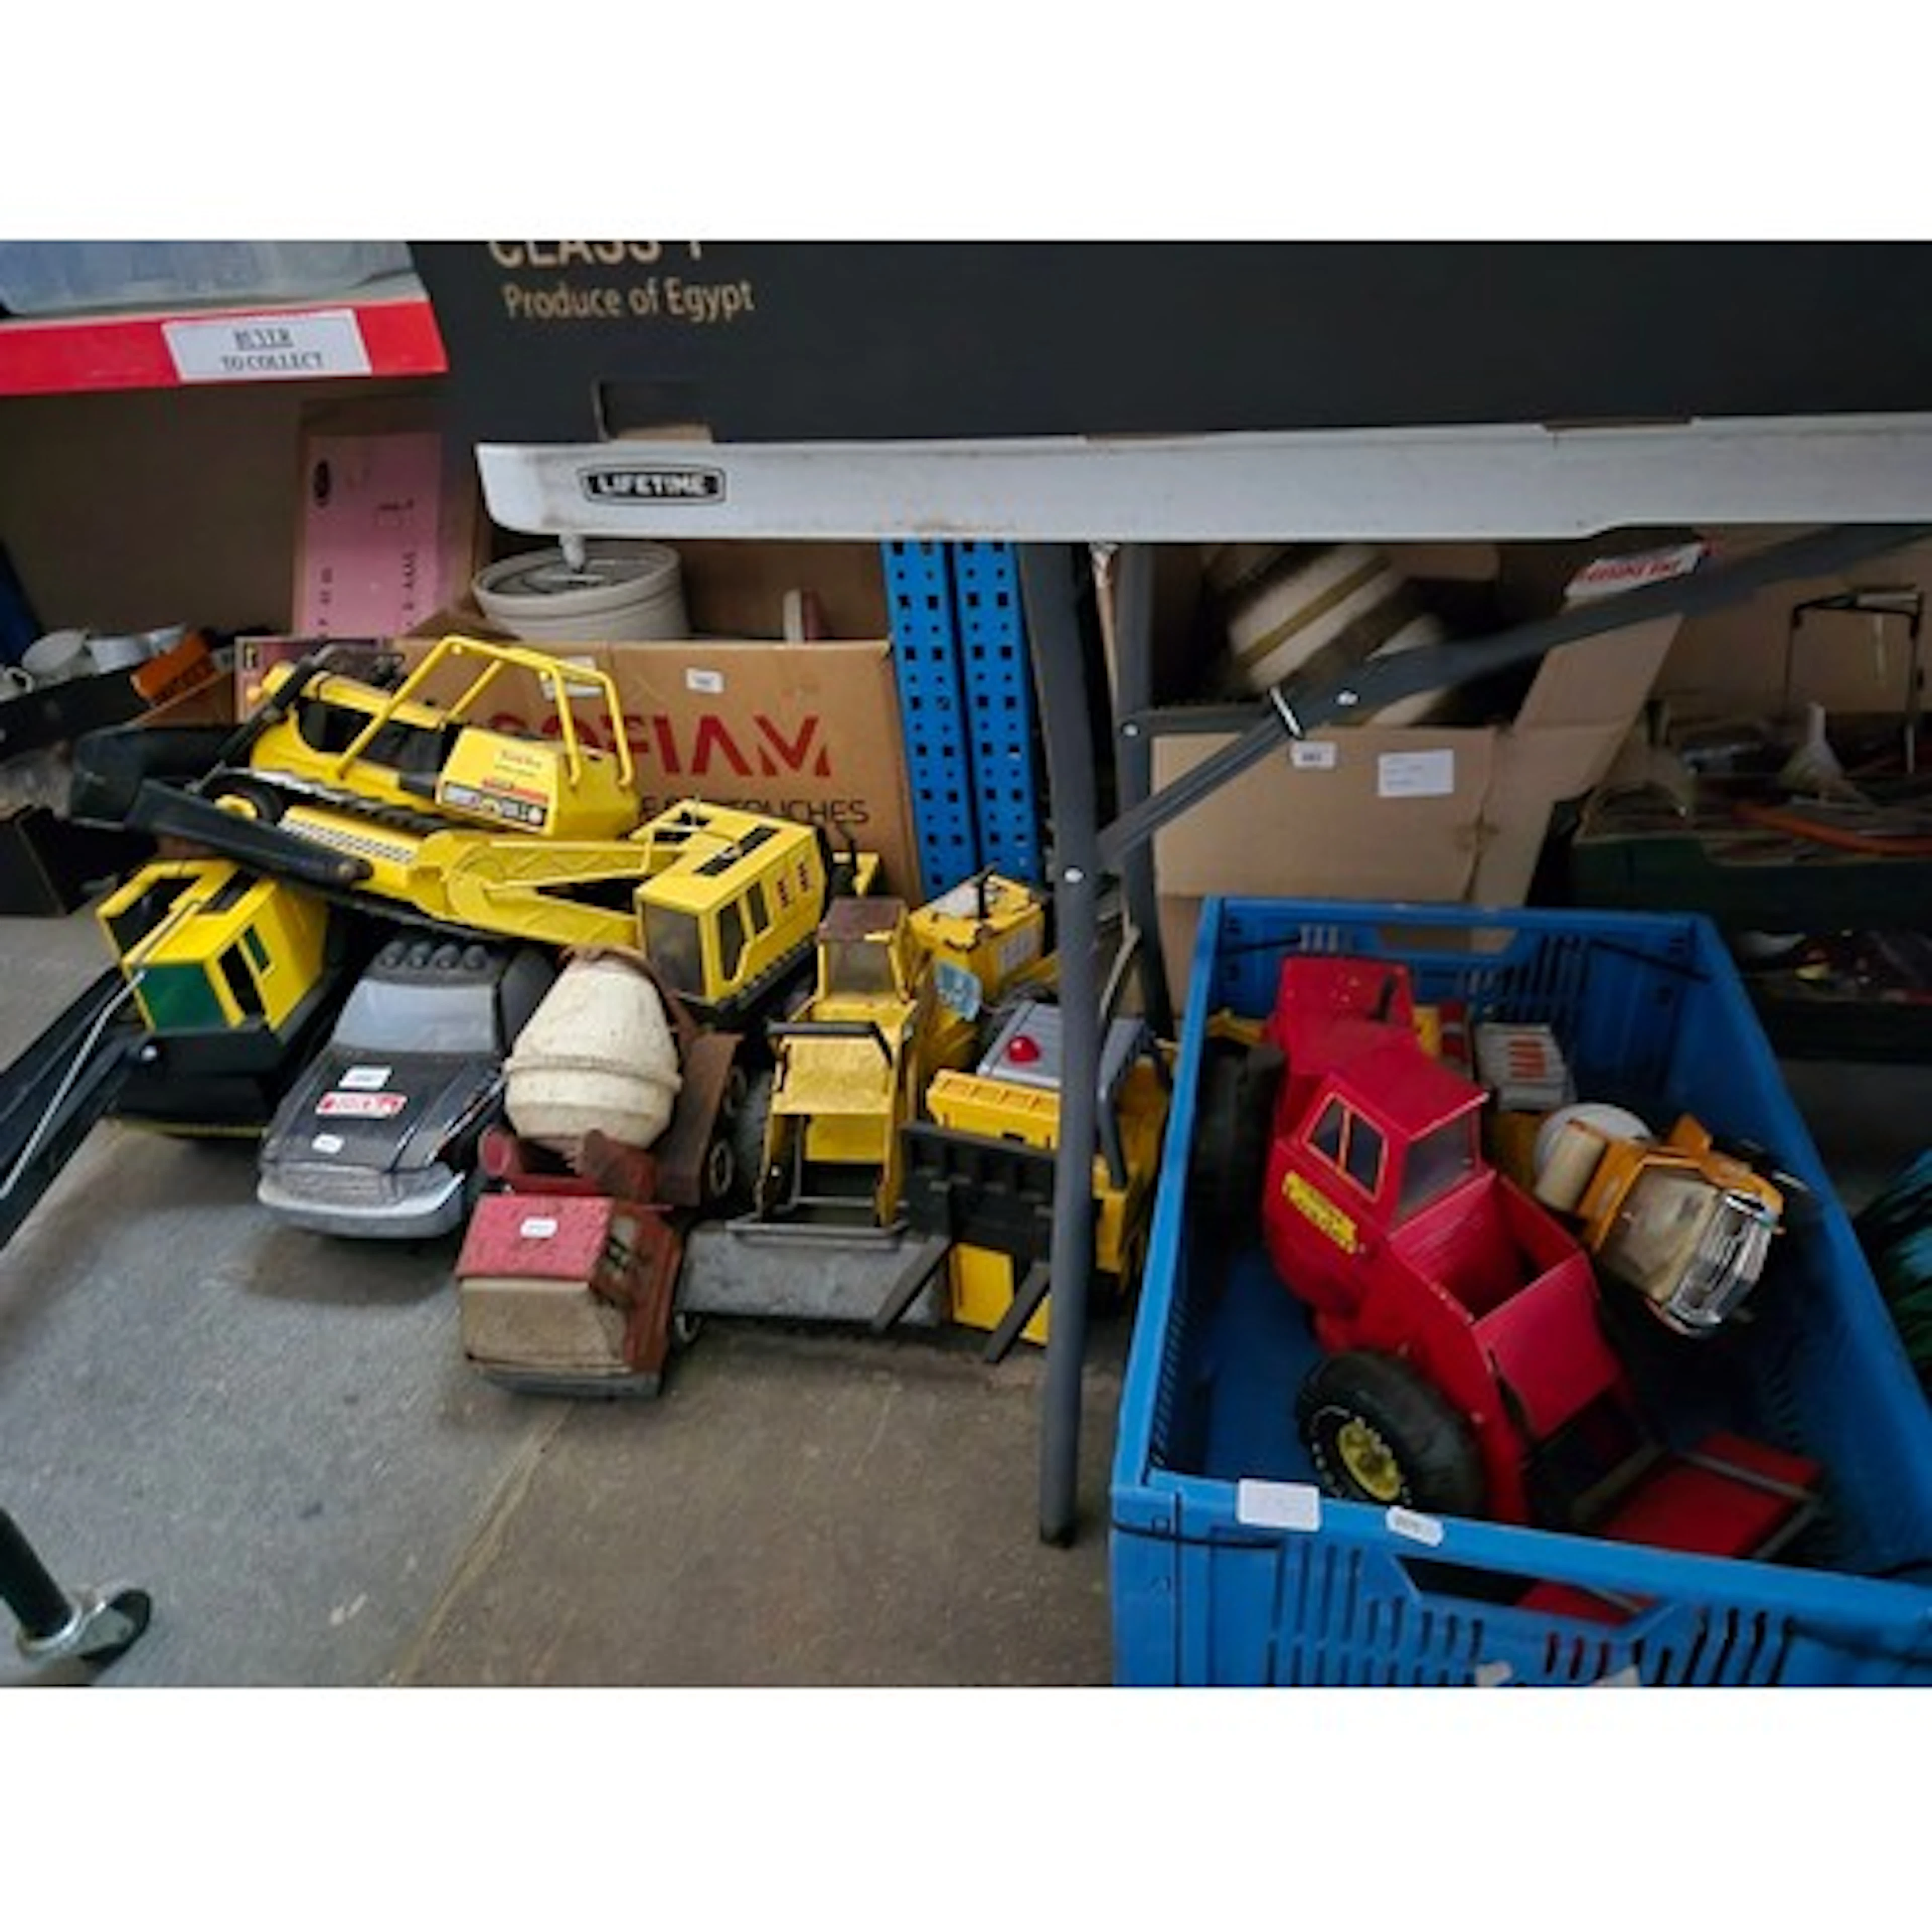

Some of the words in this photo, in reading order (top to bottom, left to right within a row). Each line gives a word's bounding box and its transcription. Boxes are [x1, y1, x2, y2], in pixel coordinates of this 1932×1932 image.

[503, 280, 622, 319] Produce
[628, 277, 660, 315] of
[663, 276, 755, 322] Egypt
[246, 351, 324, 371] COLLECT
[594, 473, 708, 496] LIFETIME
